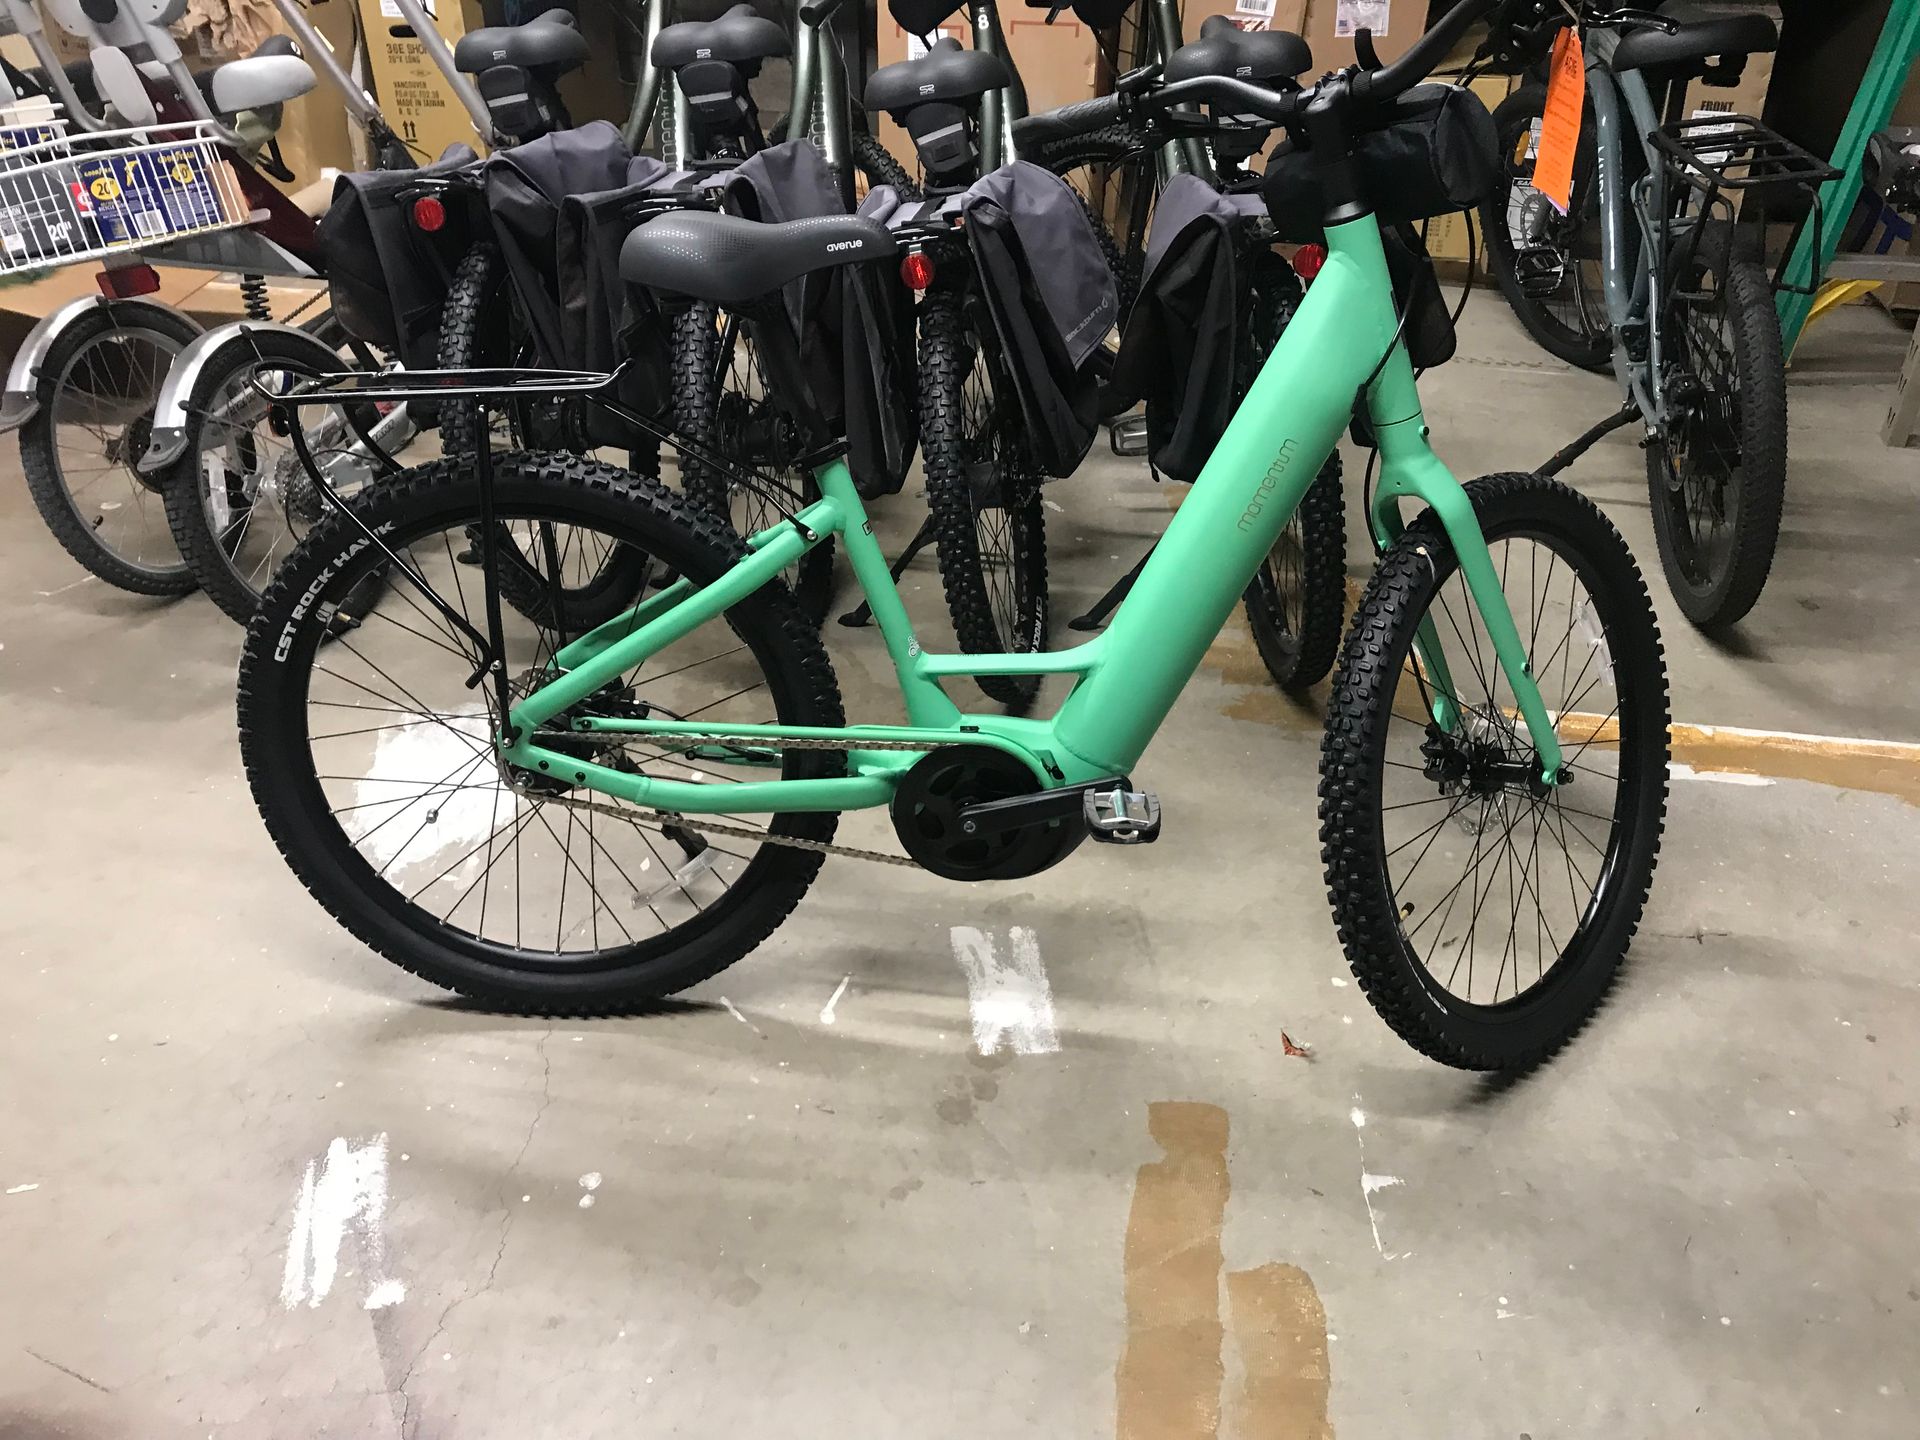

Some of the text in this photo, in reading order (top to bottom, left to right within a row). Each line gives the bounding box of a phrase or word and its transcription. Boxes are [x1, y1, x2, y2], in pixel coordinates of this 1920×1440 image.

[1700, 100, 1735, 113] FRONT
[826, 239, 863, 252] avenue
[1237, 438, 1299, 533] momentum
[274, 621, 297, 663] CST
[291, 567, 335, 621] ROCK
